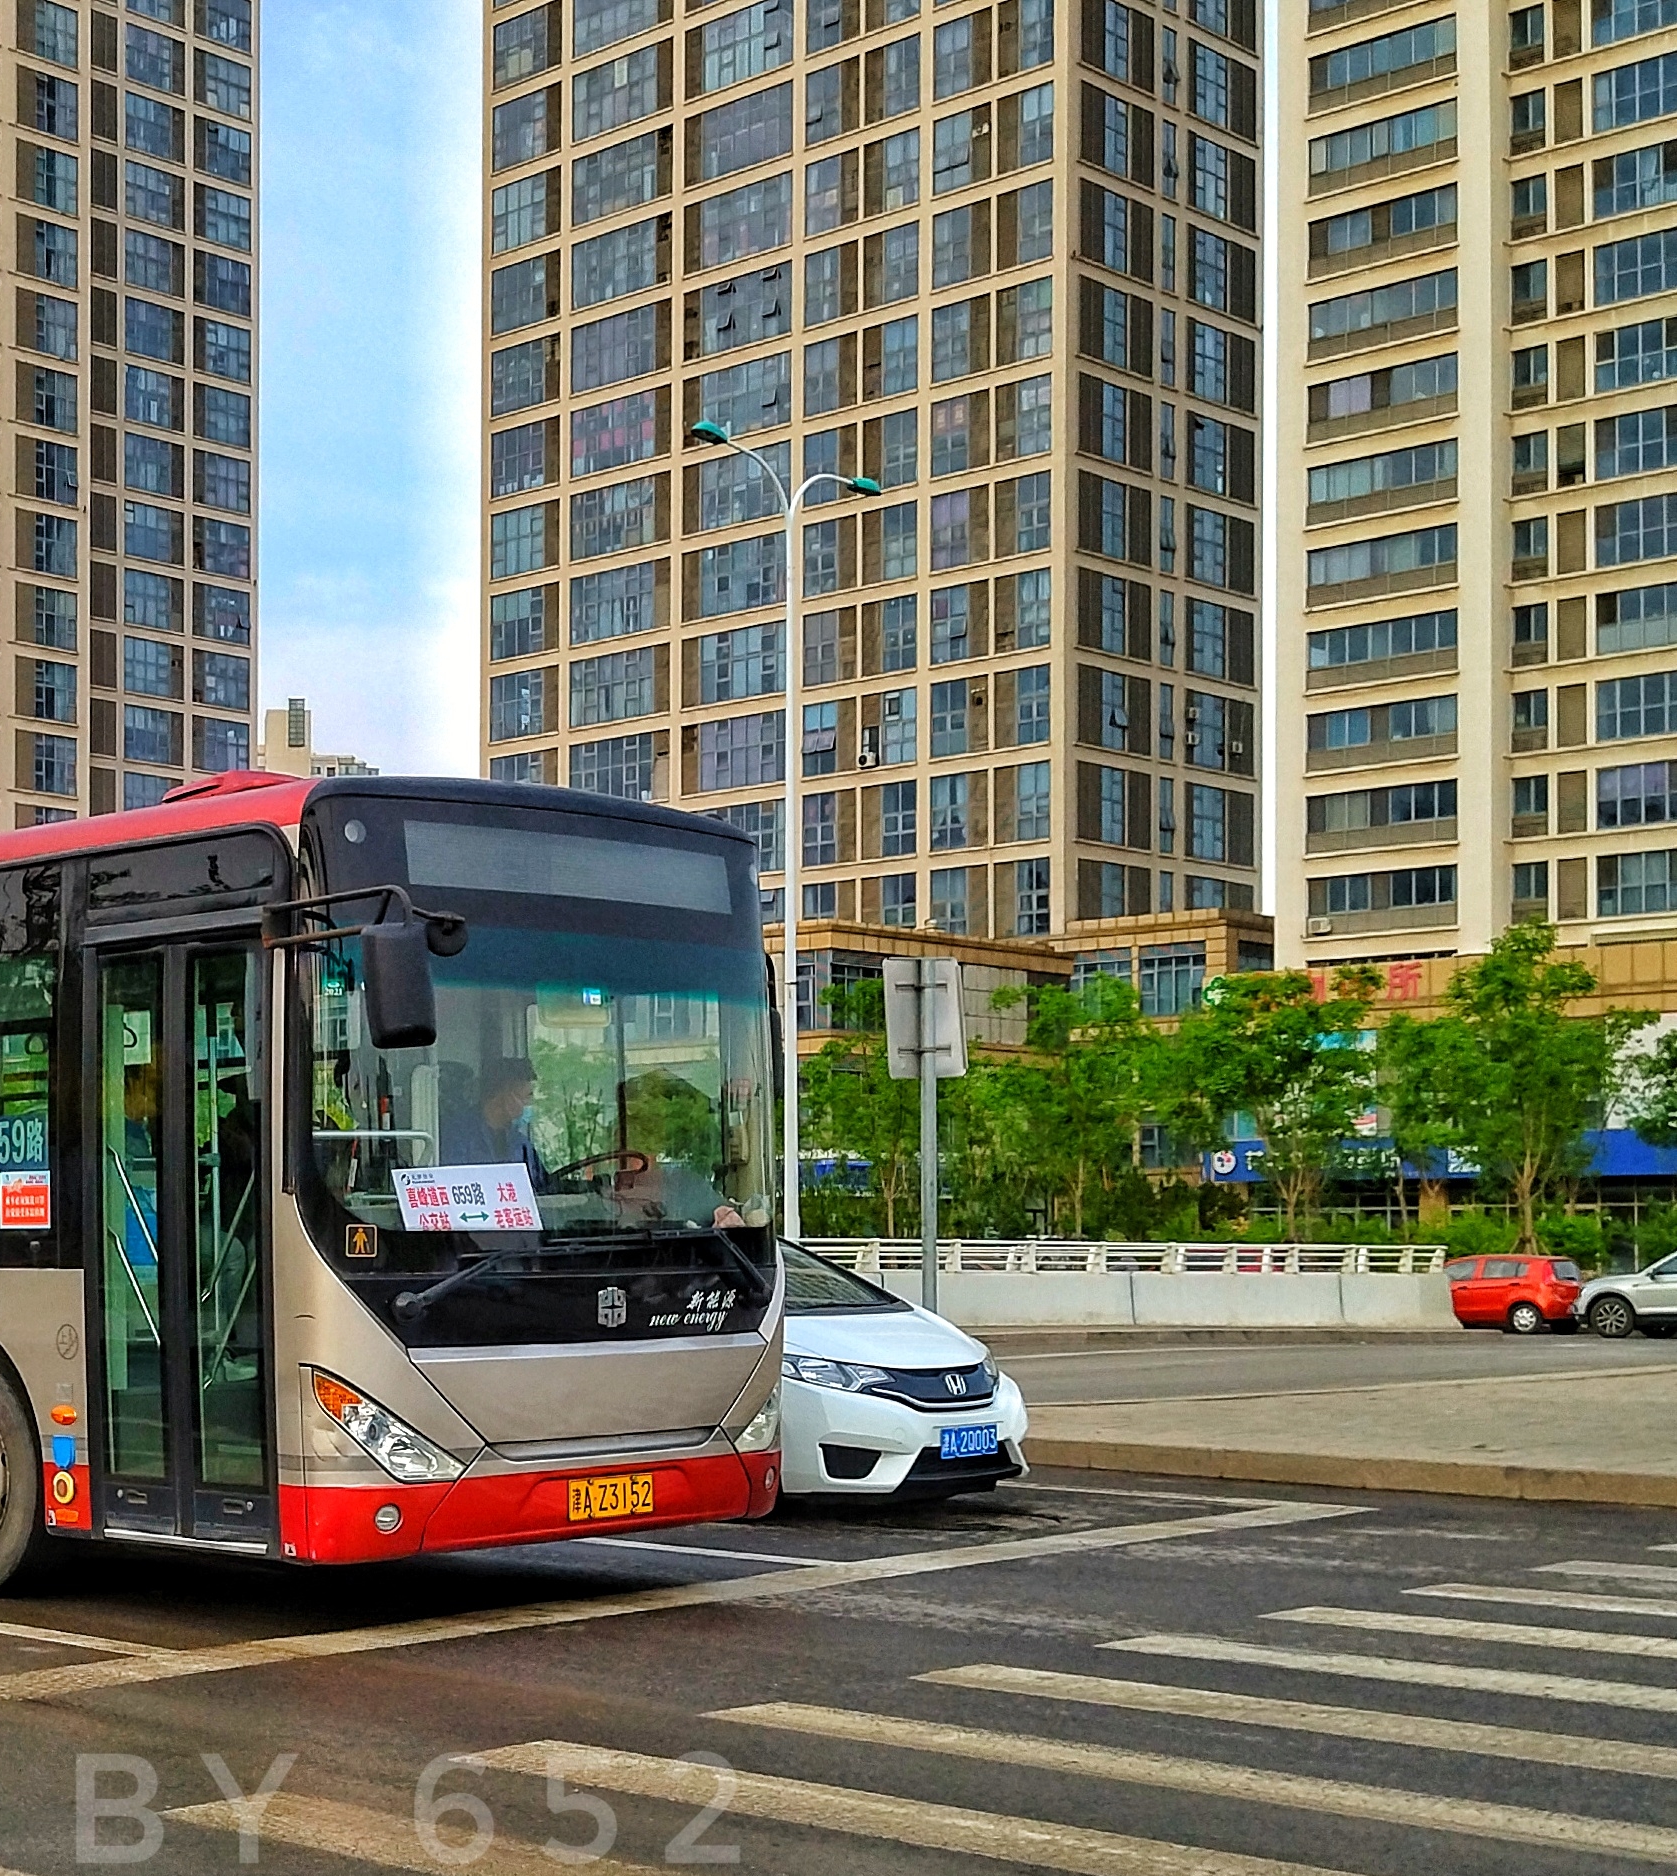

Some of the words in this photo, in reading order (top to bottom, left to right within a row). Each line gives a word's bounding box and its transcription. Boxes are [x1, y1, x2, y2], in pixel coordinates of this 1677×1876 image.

[452, 1182, 485, 1205] 659路
[497, 1182, 518, 1202] 大港
[686, 1289, 736, 1312] 新能源
[649, 1313, 681, 1327] new
[684, 1310, 728, 1332] energy
